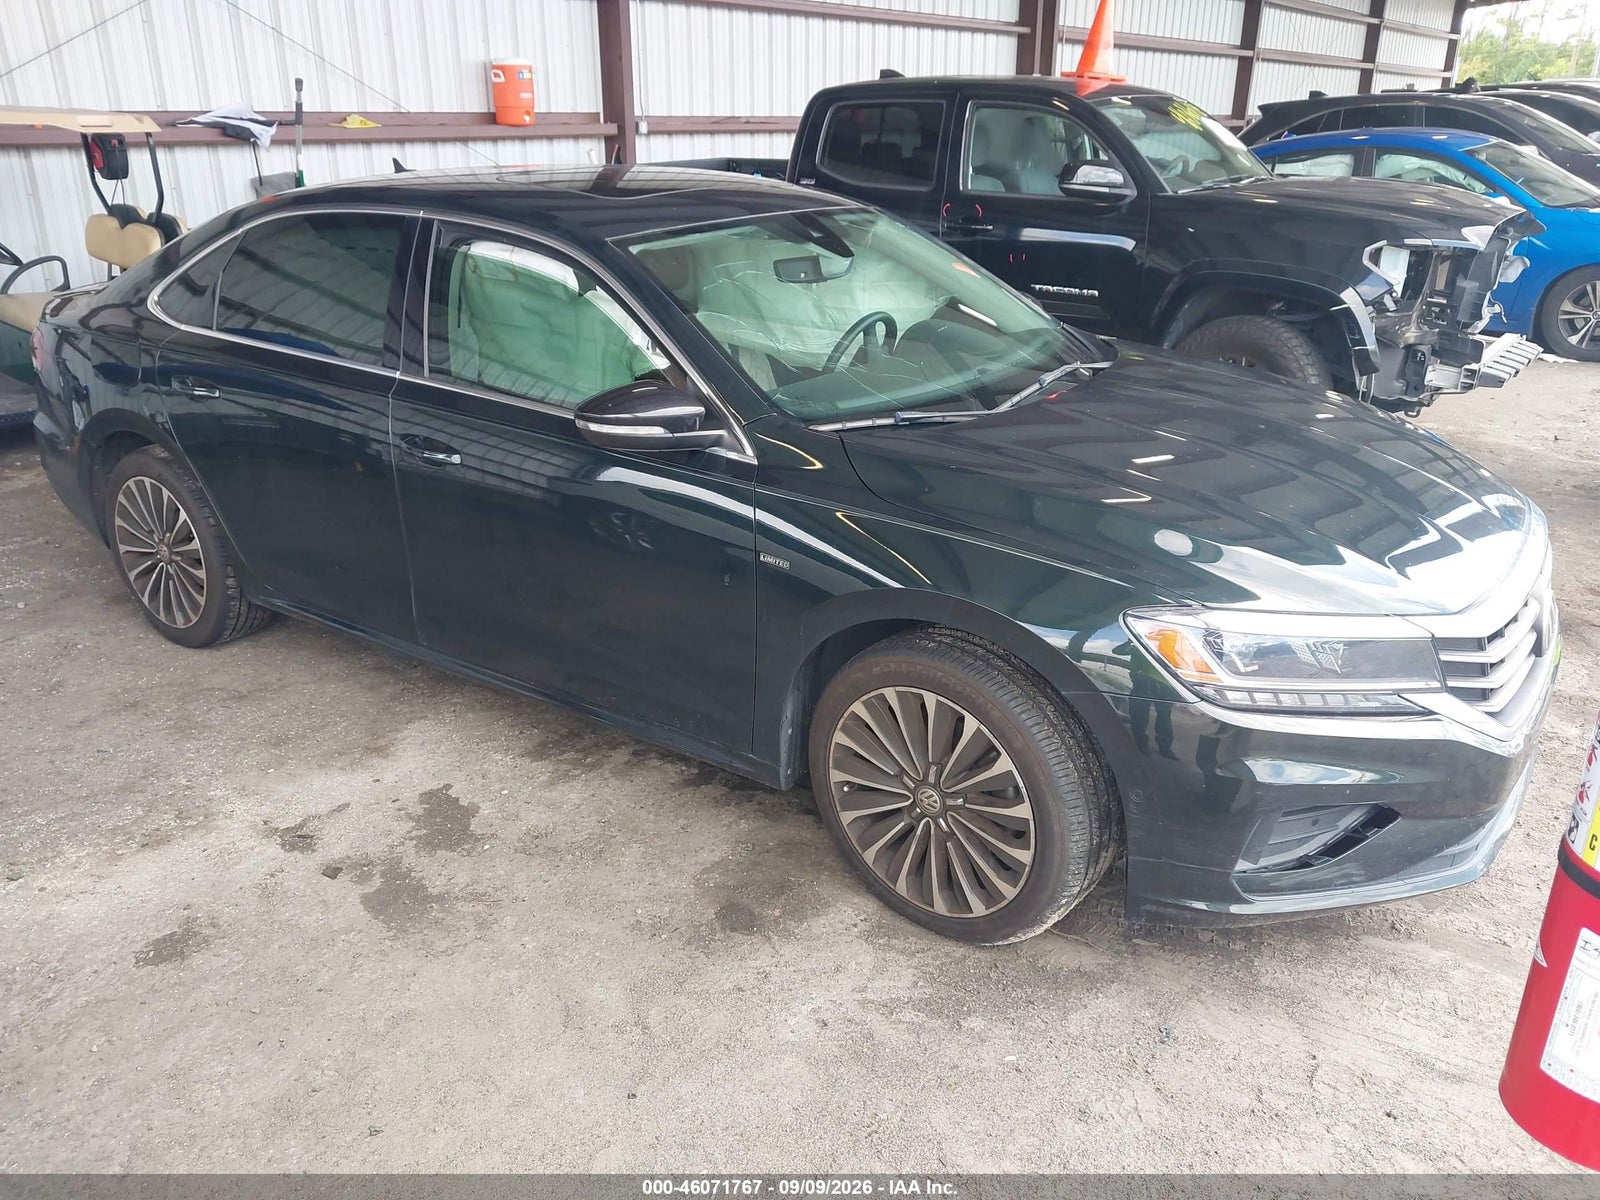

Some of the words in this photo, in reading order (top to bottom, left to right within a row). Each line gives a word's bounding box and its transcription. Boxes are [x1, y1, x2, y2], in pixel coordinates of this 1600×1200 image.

[1030, 284, 1099, 297] TACOMA
[760, 552, 790, 570] LIMITED
[1588, 833, 1598, 852] C
